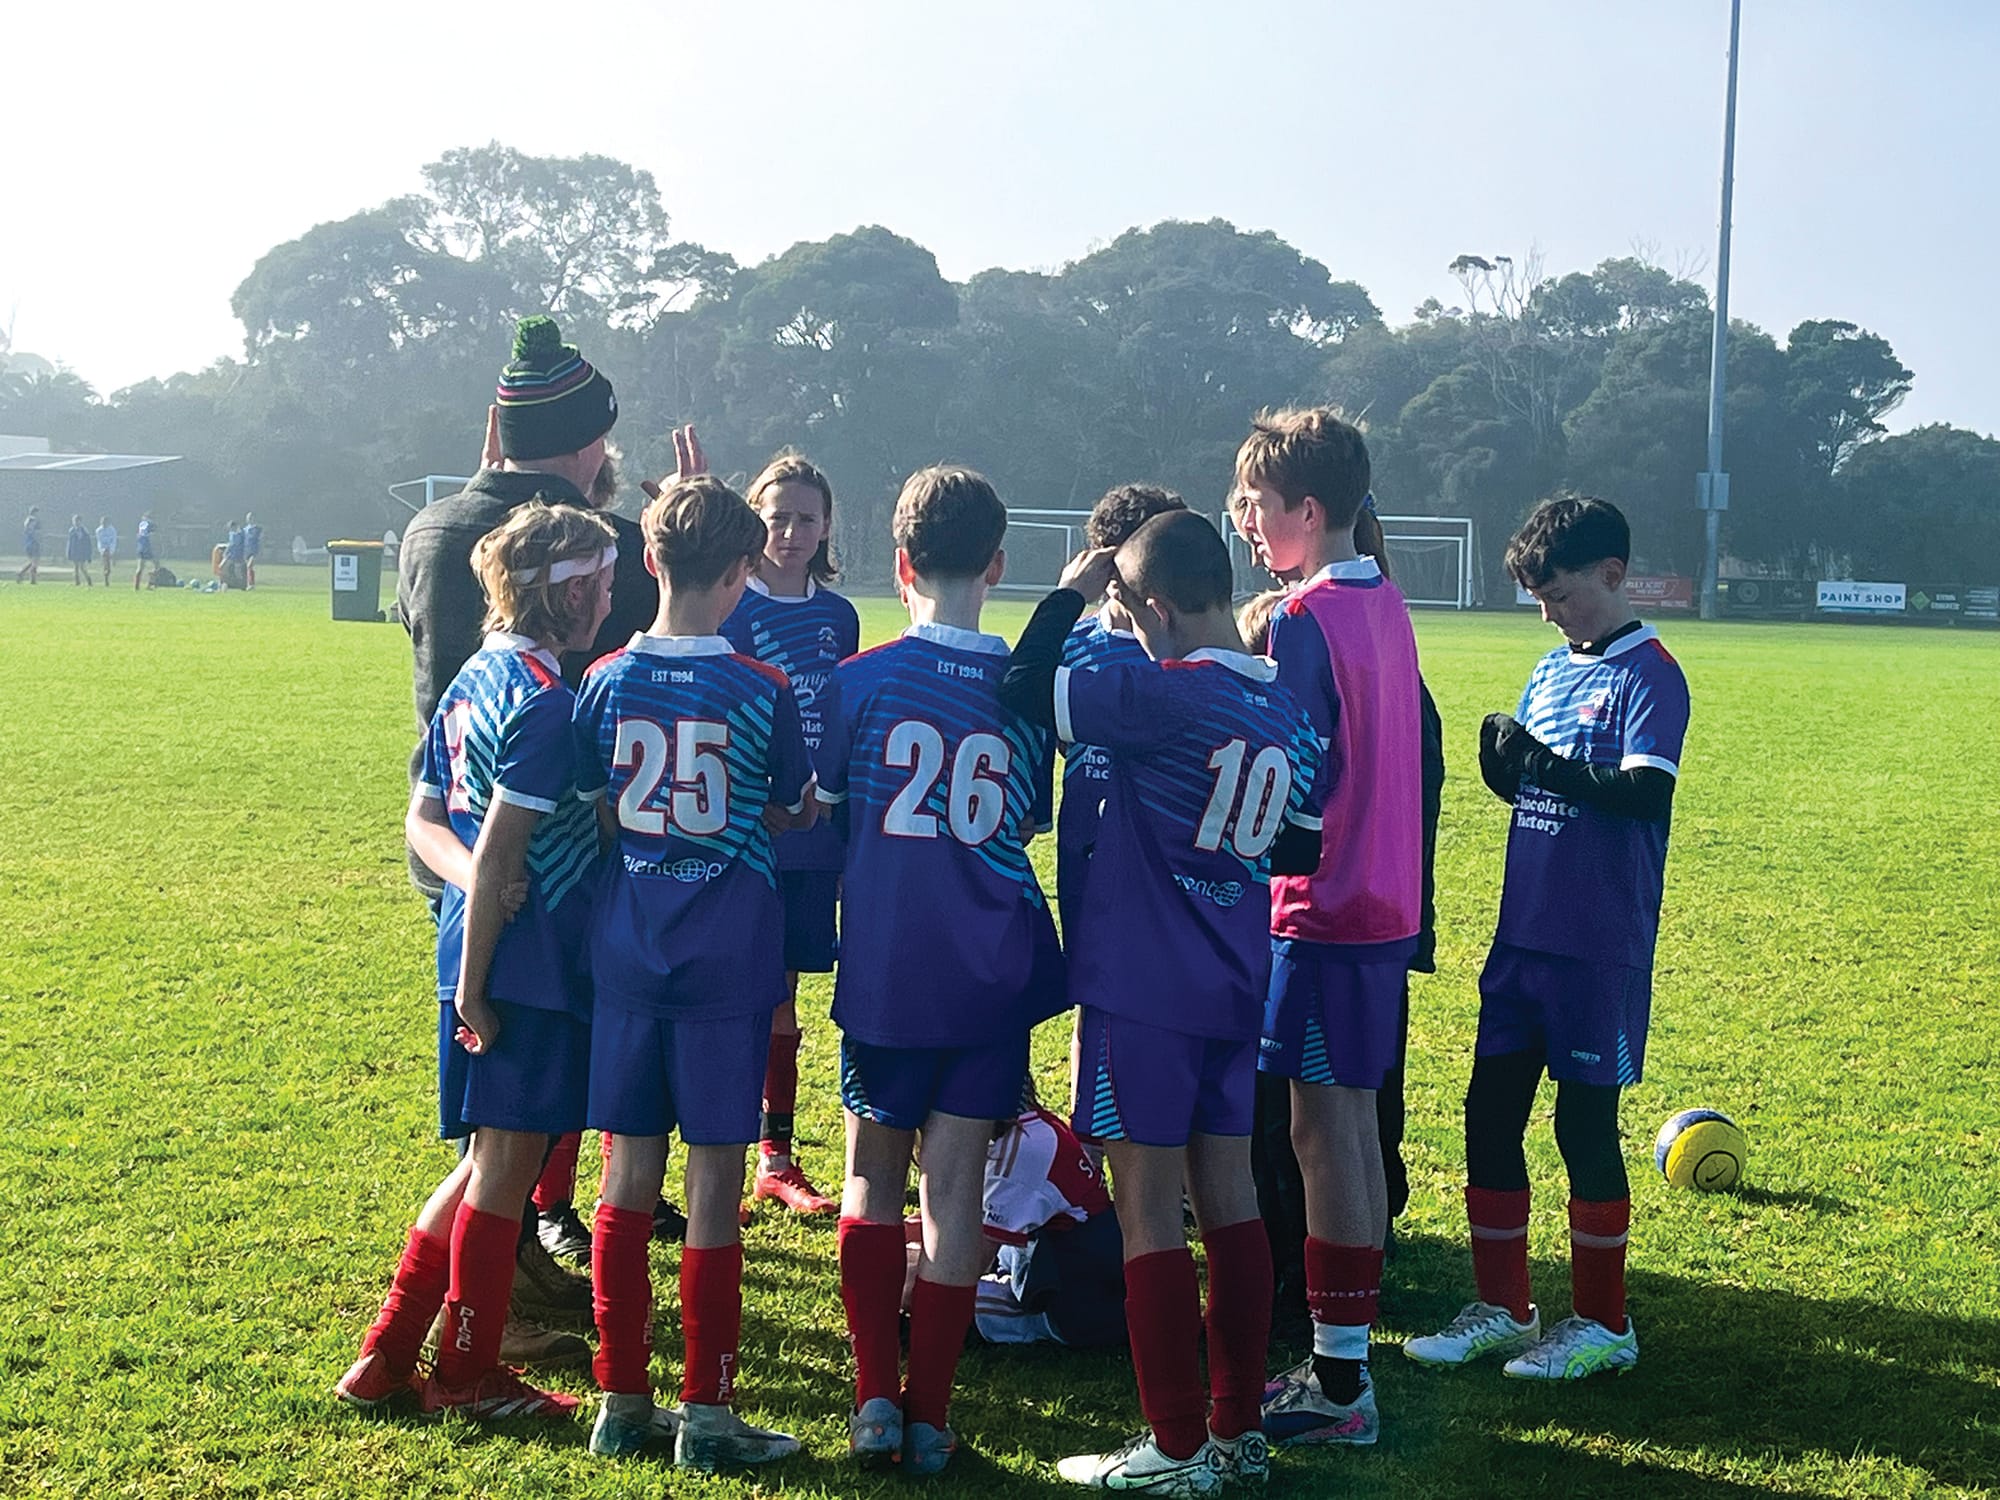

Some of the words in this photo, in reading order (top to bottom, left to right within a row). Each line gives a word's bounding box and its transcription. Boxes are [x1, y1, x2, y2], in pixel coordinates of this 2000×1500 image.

[1820, 592, 1860, 603] PAINT
[1865, 594, 1902, 605] SHOP
[651, 670, 667, 682] EST
[669, 670, 694, 684] 1994
[937, 660, 955, 675] EST
[958, 664, 984, 681] 1994
[612, 716, 731, 837] 25
[882, 718, 1013, 847] 26
[1194, 734, 1292, 858] 10
